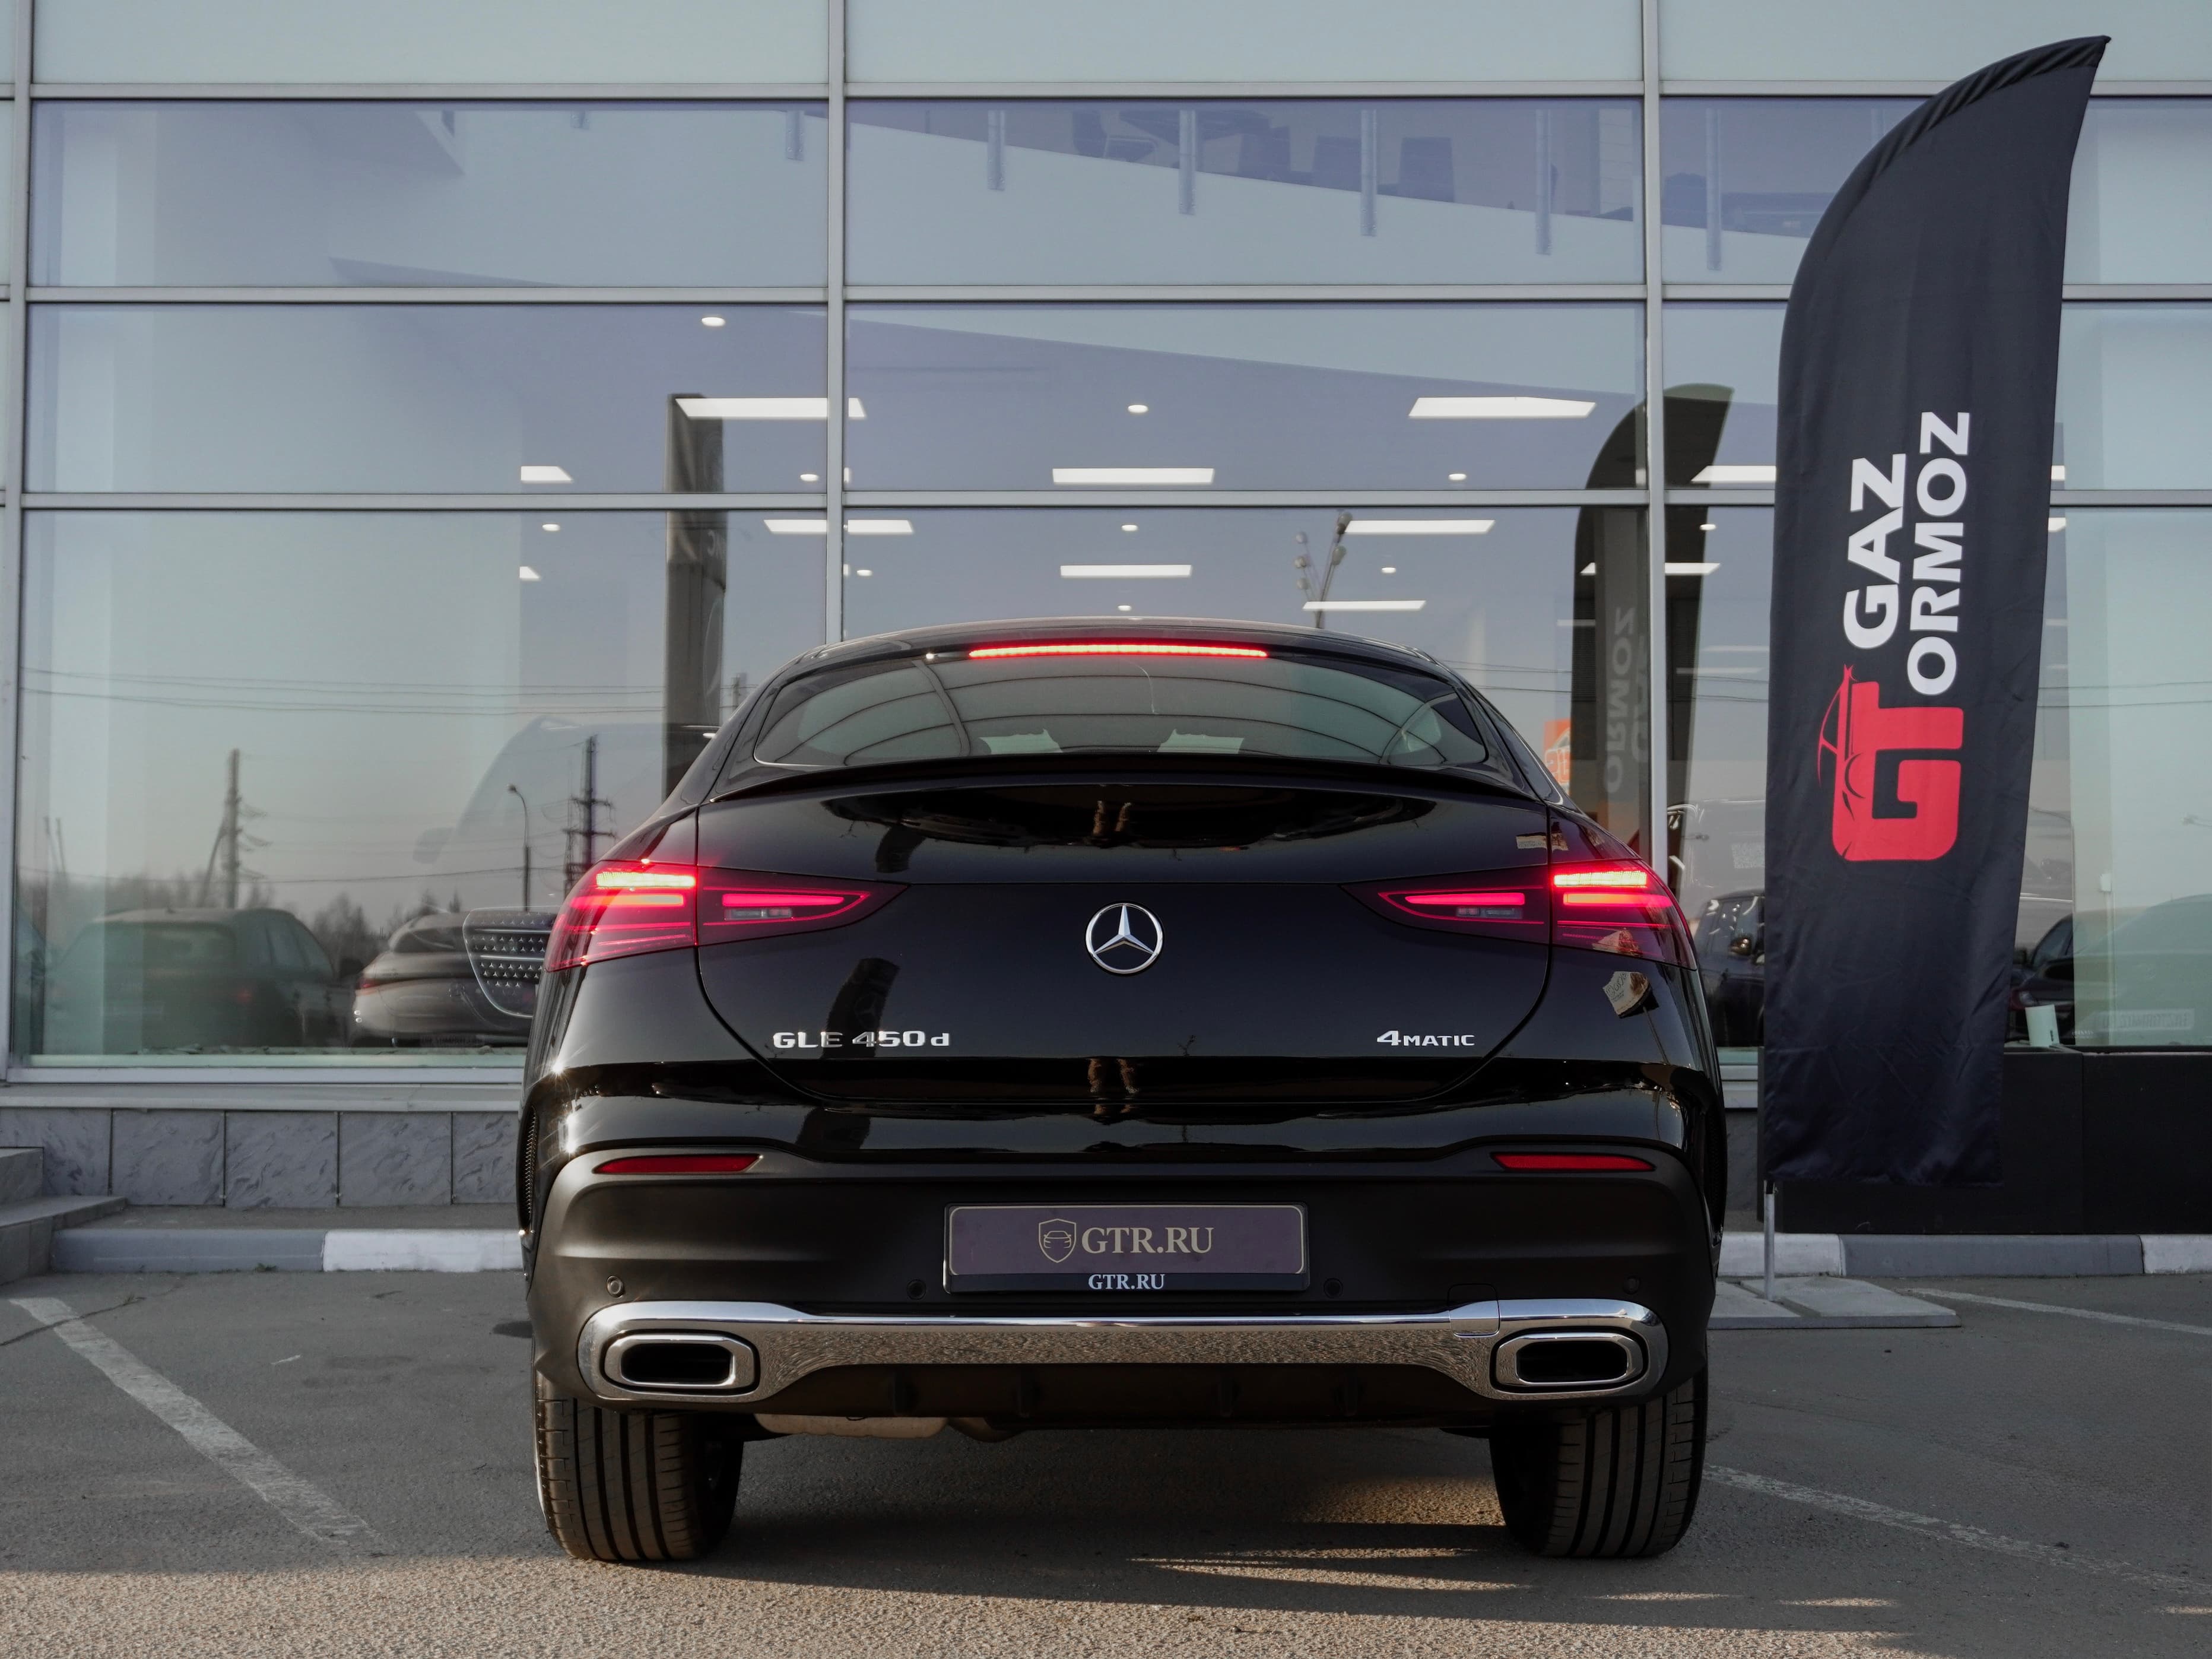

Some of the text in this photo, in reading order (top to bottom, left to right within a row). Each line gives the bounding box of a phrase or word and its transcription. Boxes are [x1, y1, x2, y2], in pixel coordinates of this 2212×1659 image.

[1843, 453, 1906, 649] GAZ
[1907, 411, 1970, 695] ORMOZ
[773, 1031, 843, 1048] GLE
[1376, 1030, 1475, 1046] 4MATIC
[1081, 1227, 1214, 1254] GTR.RU
[1088, 1274, 1165, 1290] GTR.RU
